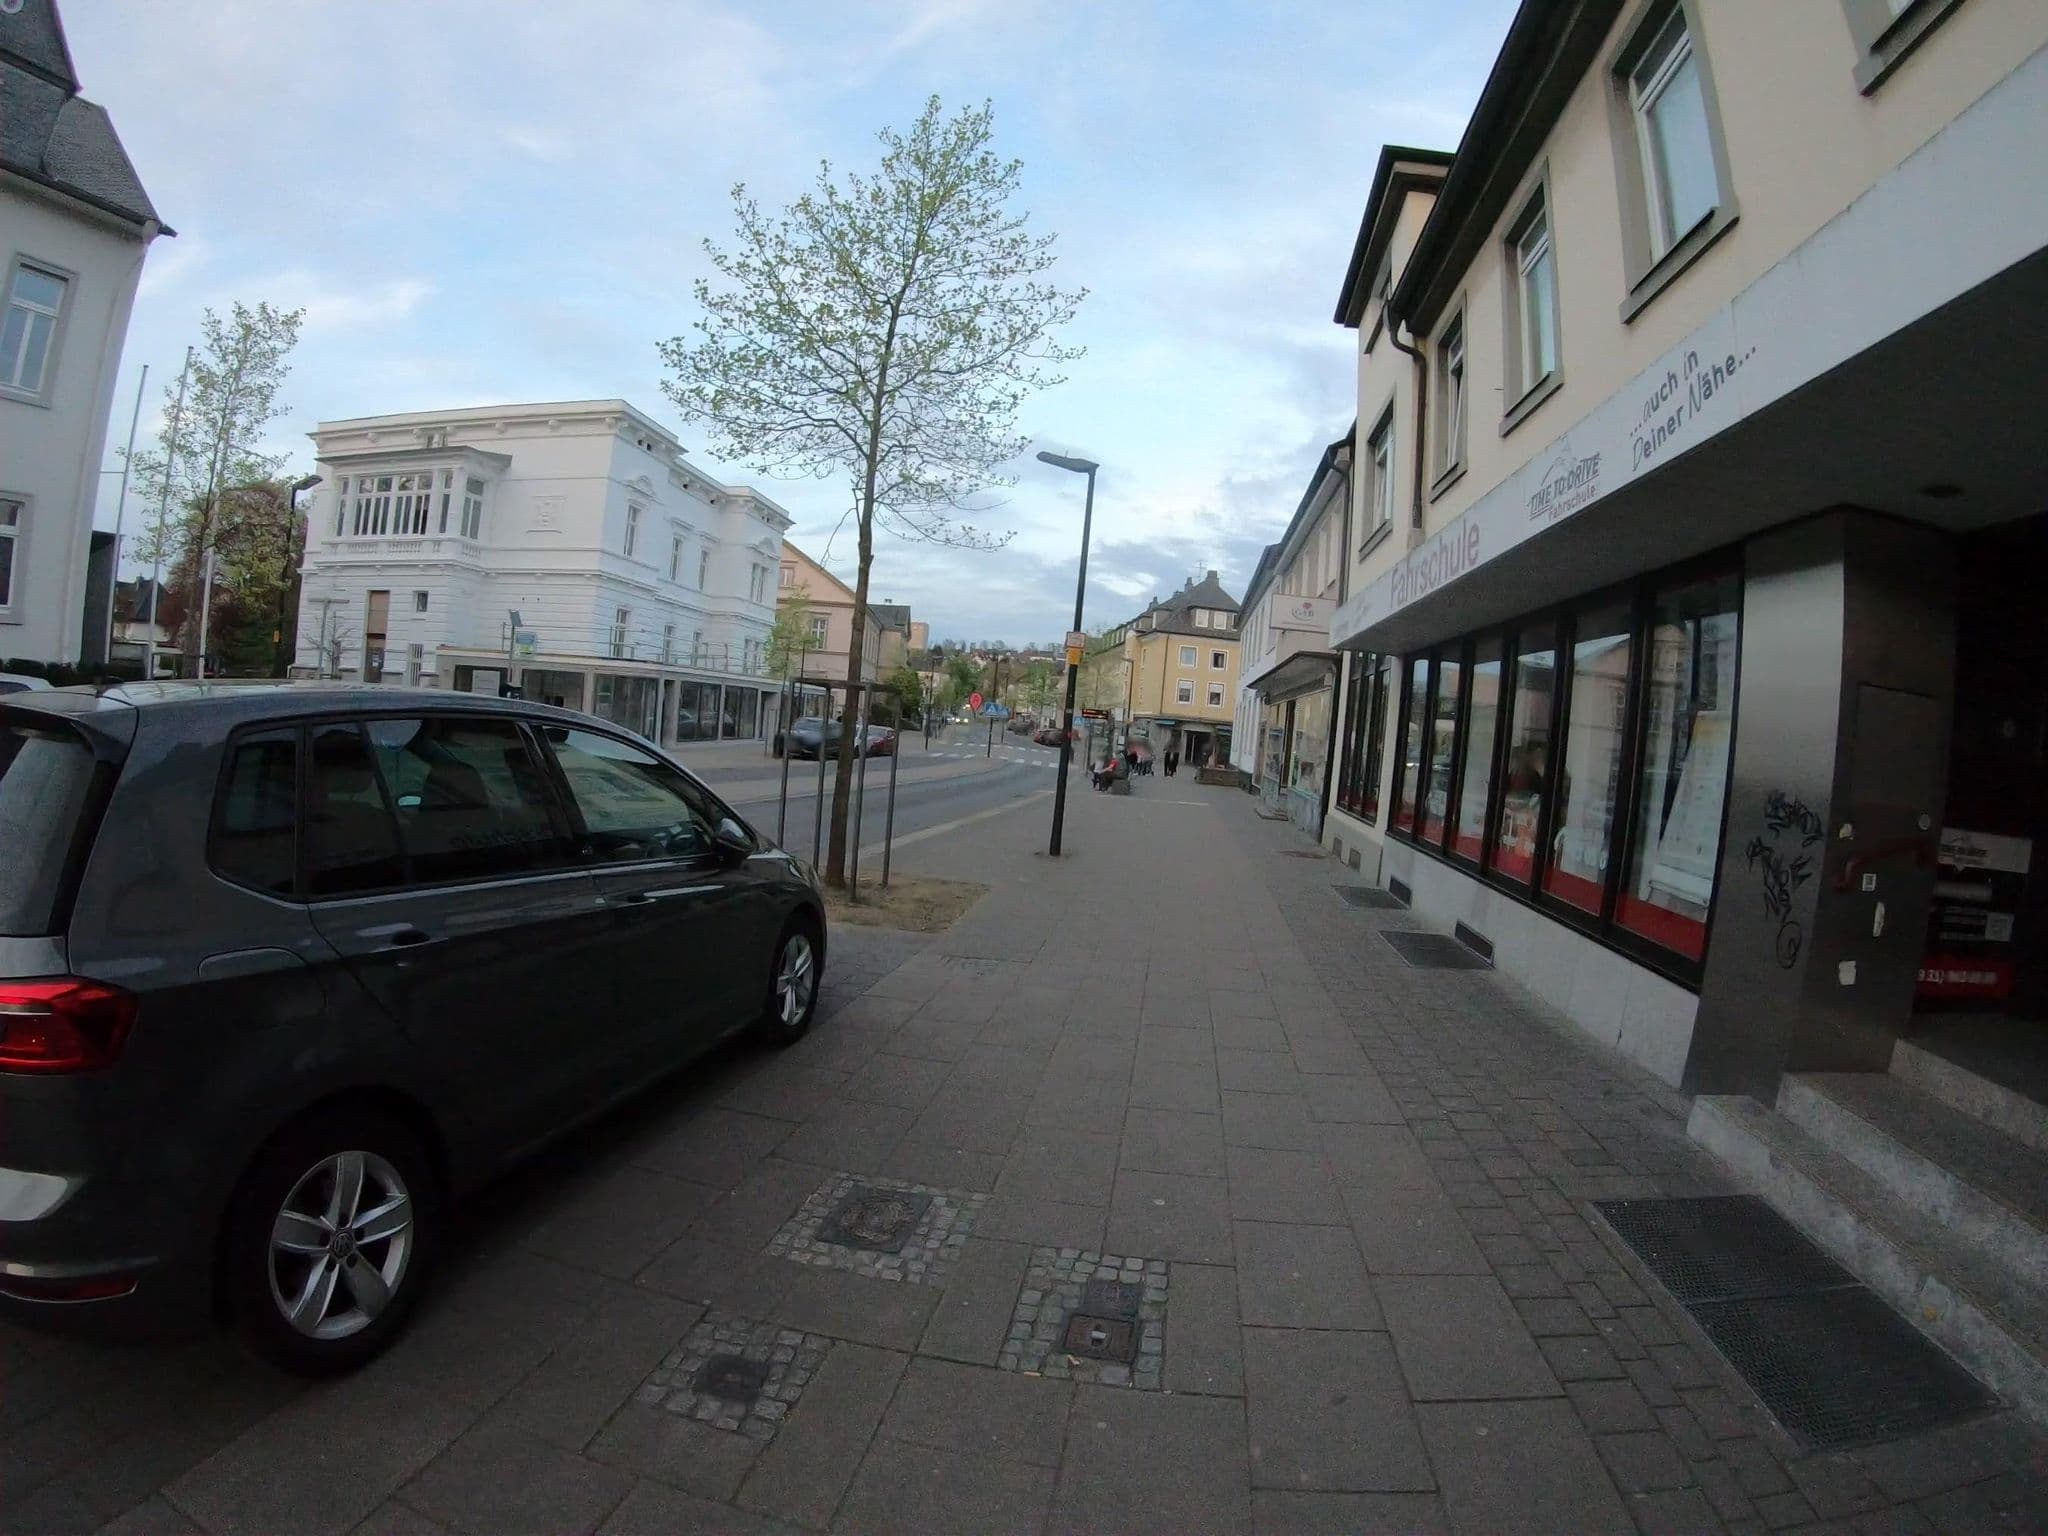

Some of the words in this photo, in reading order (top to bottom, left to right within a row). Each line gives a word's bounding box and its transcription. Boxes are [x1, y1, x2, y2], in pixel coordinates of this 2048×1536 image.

[1682, 350, 1699, 381] in
[1632, 404, 1683, 472] Deiner
[1553, 476, 1566, 500] TO
[1566, 456, 1600, 491] DRIVE
[1547, 484, 1597, 521] Fahrschule
[1390, 518, 1480, 610] Fahrschule
